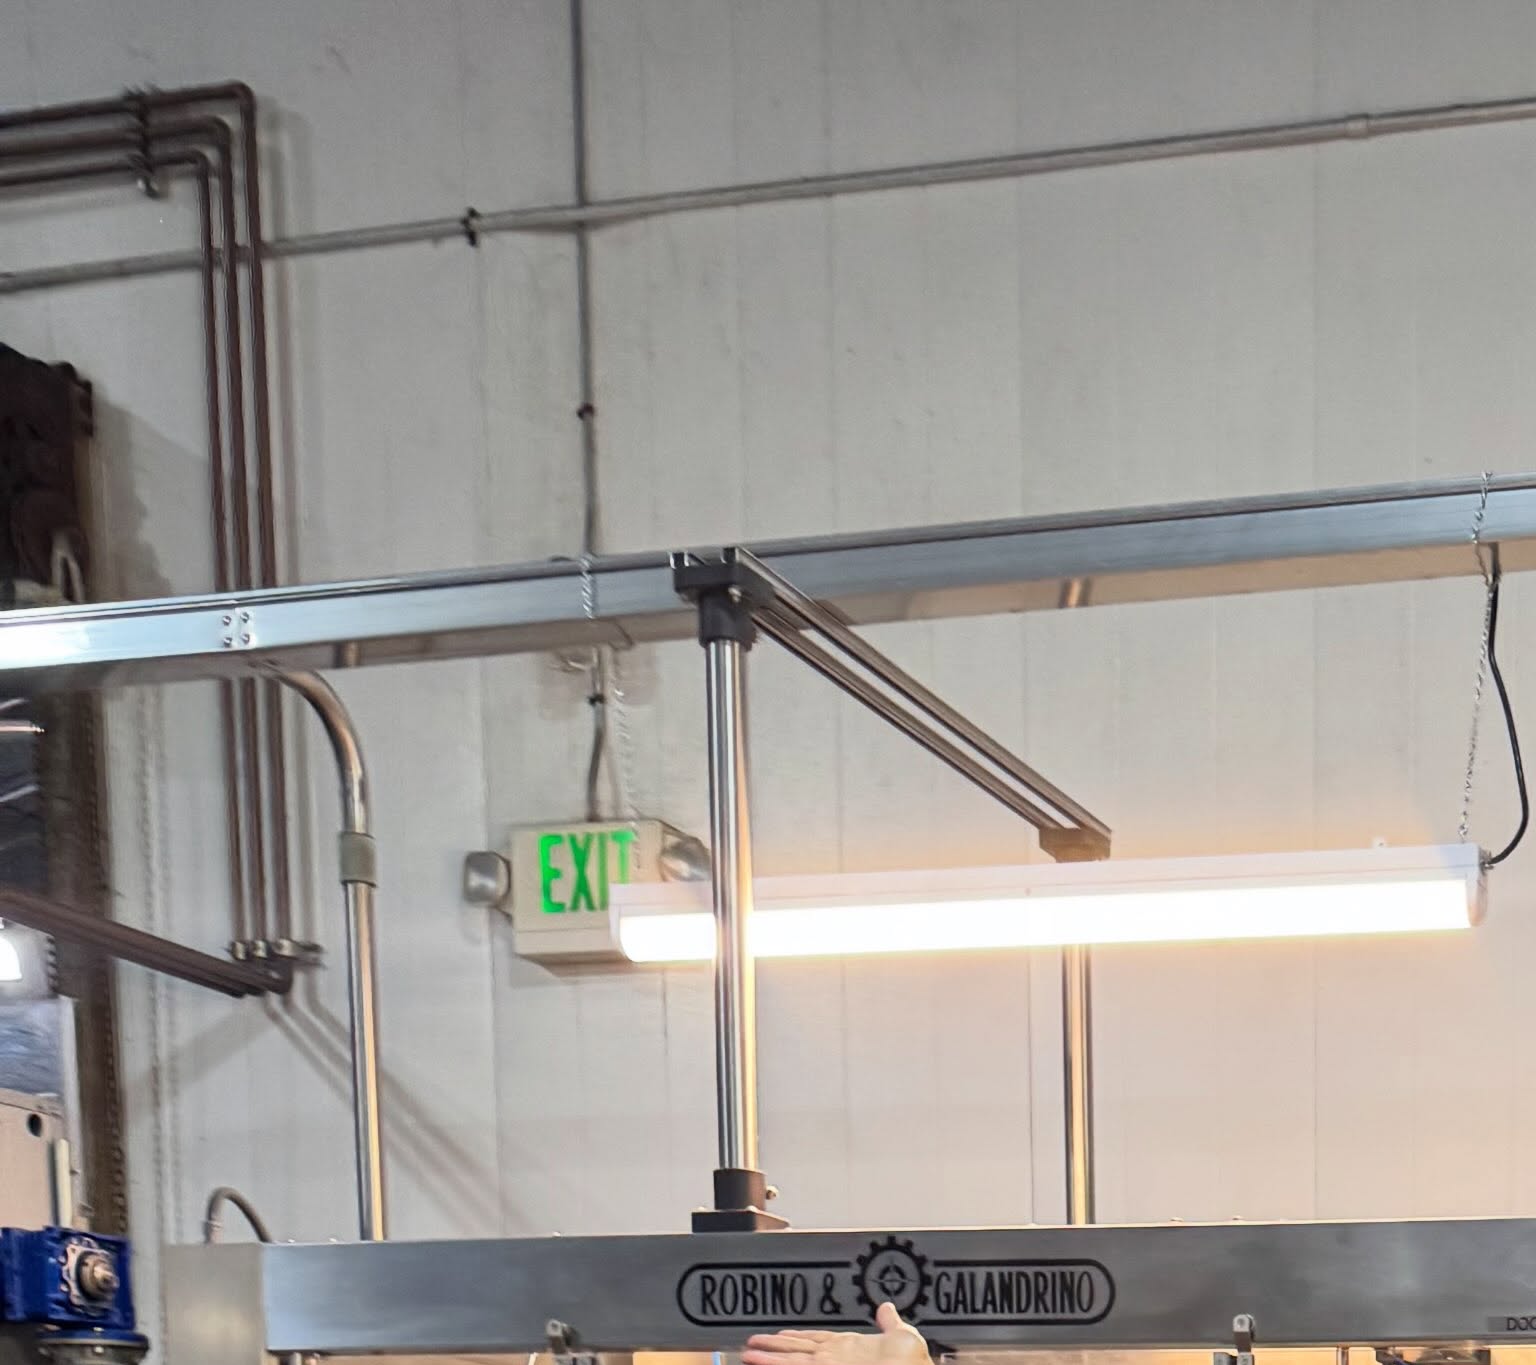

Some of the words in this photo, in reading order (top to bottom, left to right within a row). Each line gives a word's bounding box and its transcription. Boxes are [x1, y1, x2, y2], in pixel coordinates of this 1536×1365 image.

[538, 829, 635, 914] EXIT
[700, 1272, 808, 1316] ROBINO
[819, 1271, 842, 1315] &
[933, 1271, 1095, 1315] GALANDRINO
